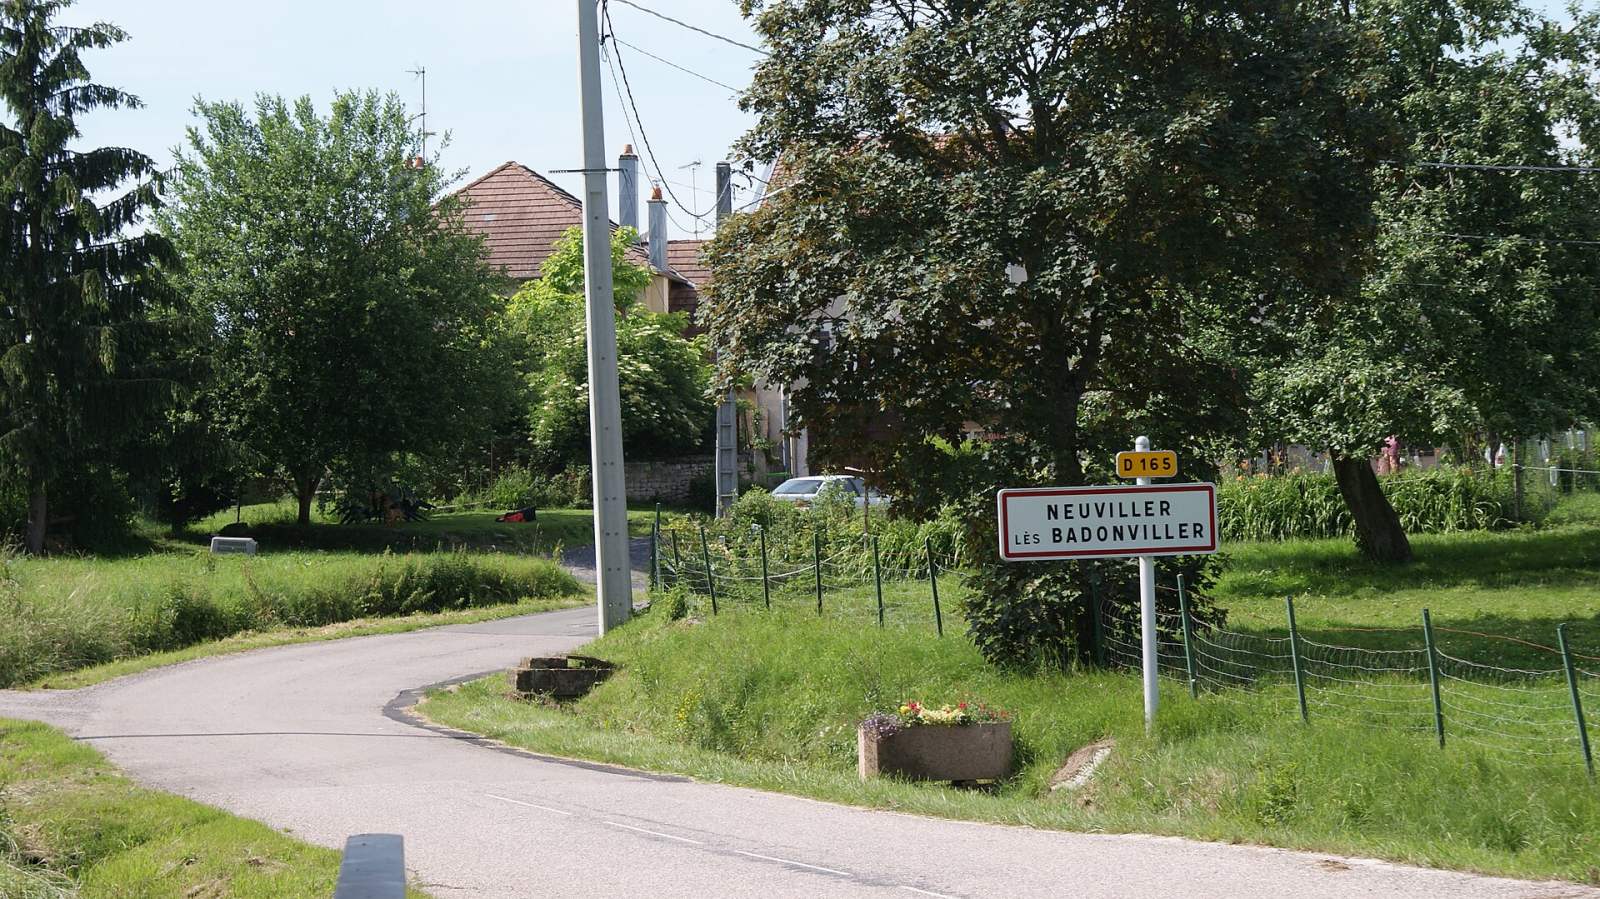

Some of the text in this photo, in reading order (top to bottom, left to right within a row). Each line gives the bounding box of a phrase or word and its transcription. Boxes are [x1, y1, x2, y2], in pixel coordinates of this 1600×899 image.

[1123, 457, 1172, 472] D 165
[1047, 500, 1171, 521] NEUVILLER
[1015, 522, 1204, 546] LÈS BADONVILLER
